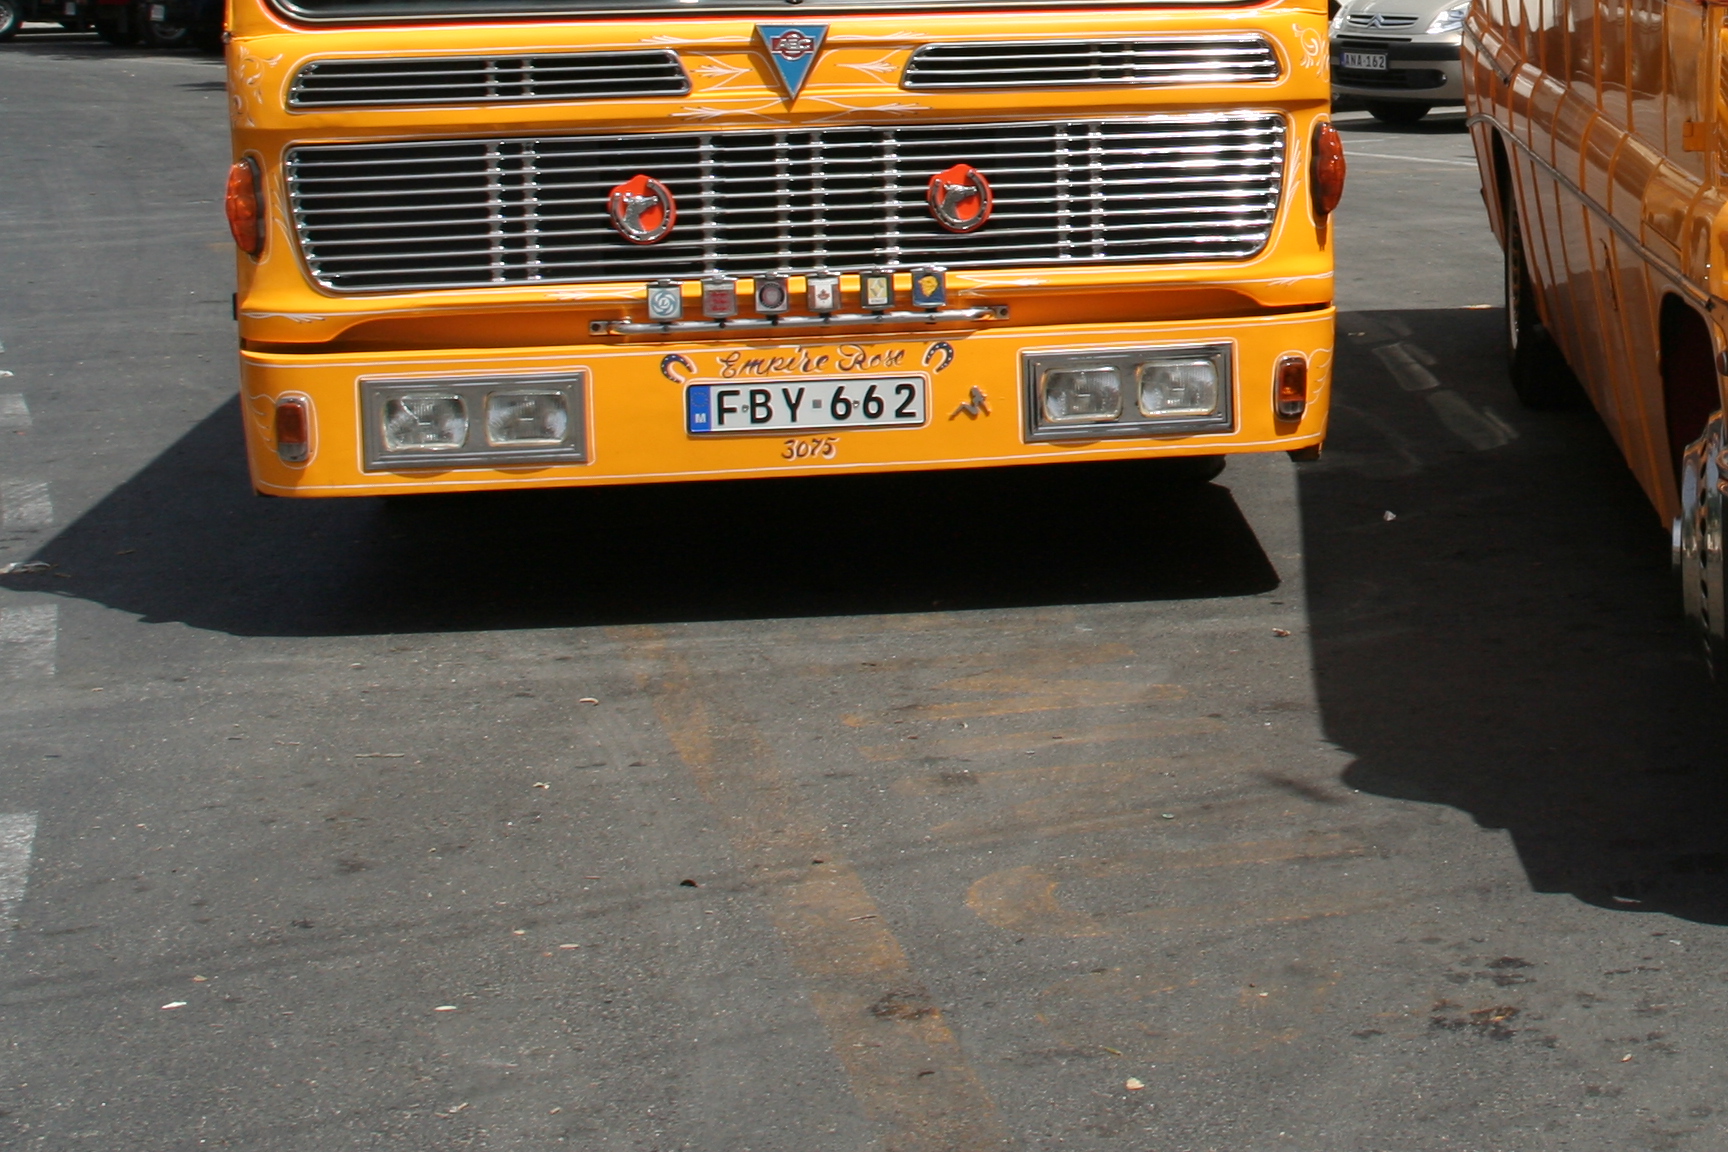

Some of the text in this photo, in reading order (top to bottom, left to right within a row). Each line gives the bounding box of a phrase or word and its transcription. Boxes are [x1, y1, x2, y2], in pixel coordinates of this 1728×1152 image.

[776, 38, 812, 50] AEC
[717, 344, 906, 378] Empire Rose
[781, 438, 840, 461] 3075
